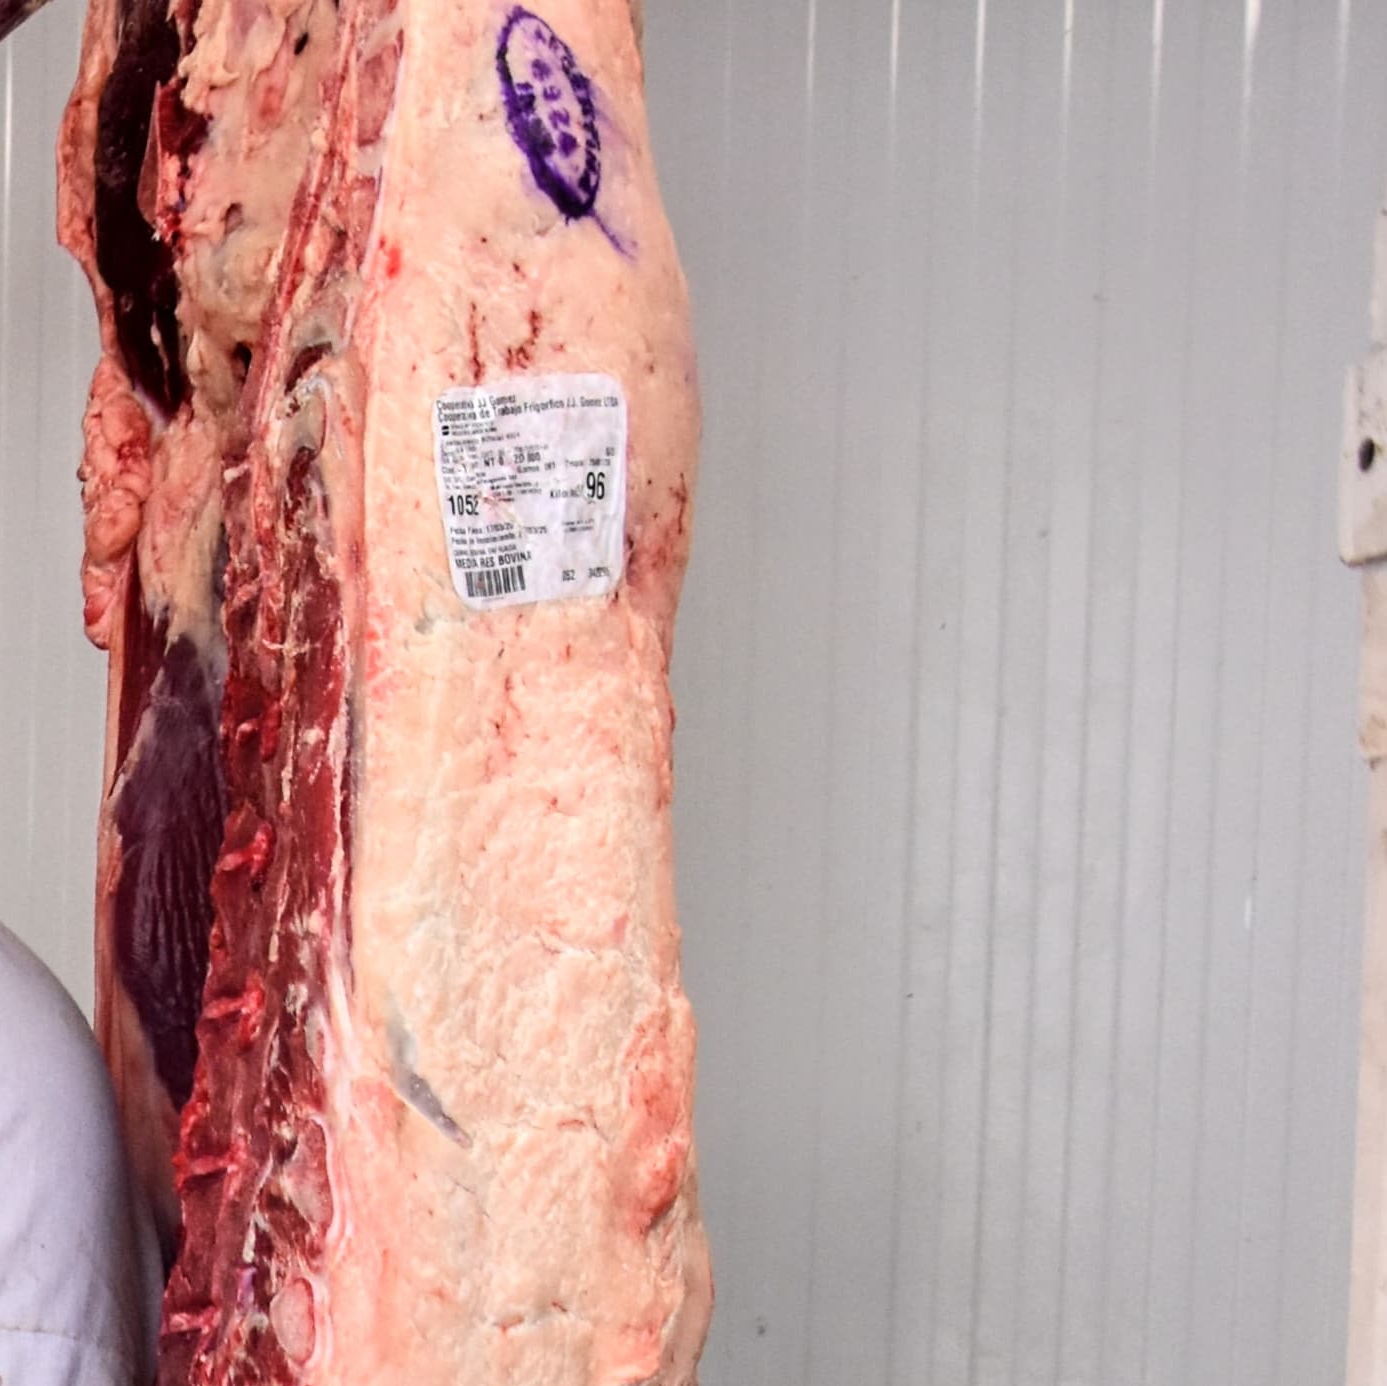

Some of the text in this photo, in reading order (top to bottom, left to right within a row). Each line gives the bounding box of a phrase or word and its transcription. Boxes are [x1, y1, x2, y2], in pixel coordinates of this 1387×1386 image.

[586, 471, 606, 500] 96
[480, 556, 495, 568] RES
[498, 550, 532, 566] BOVINA
